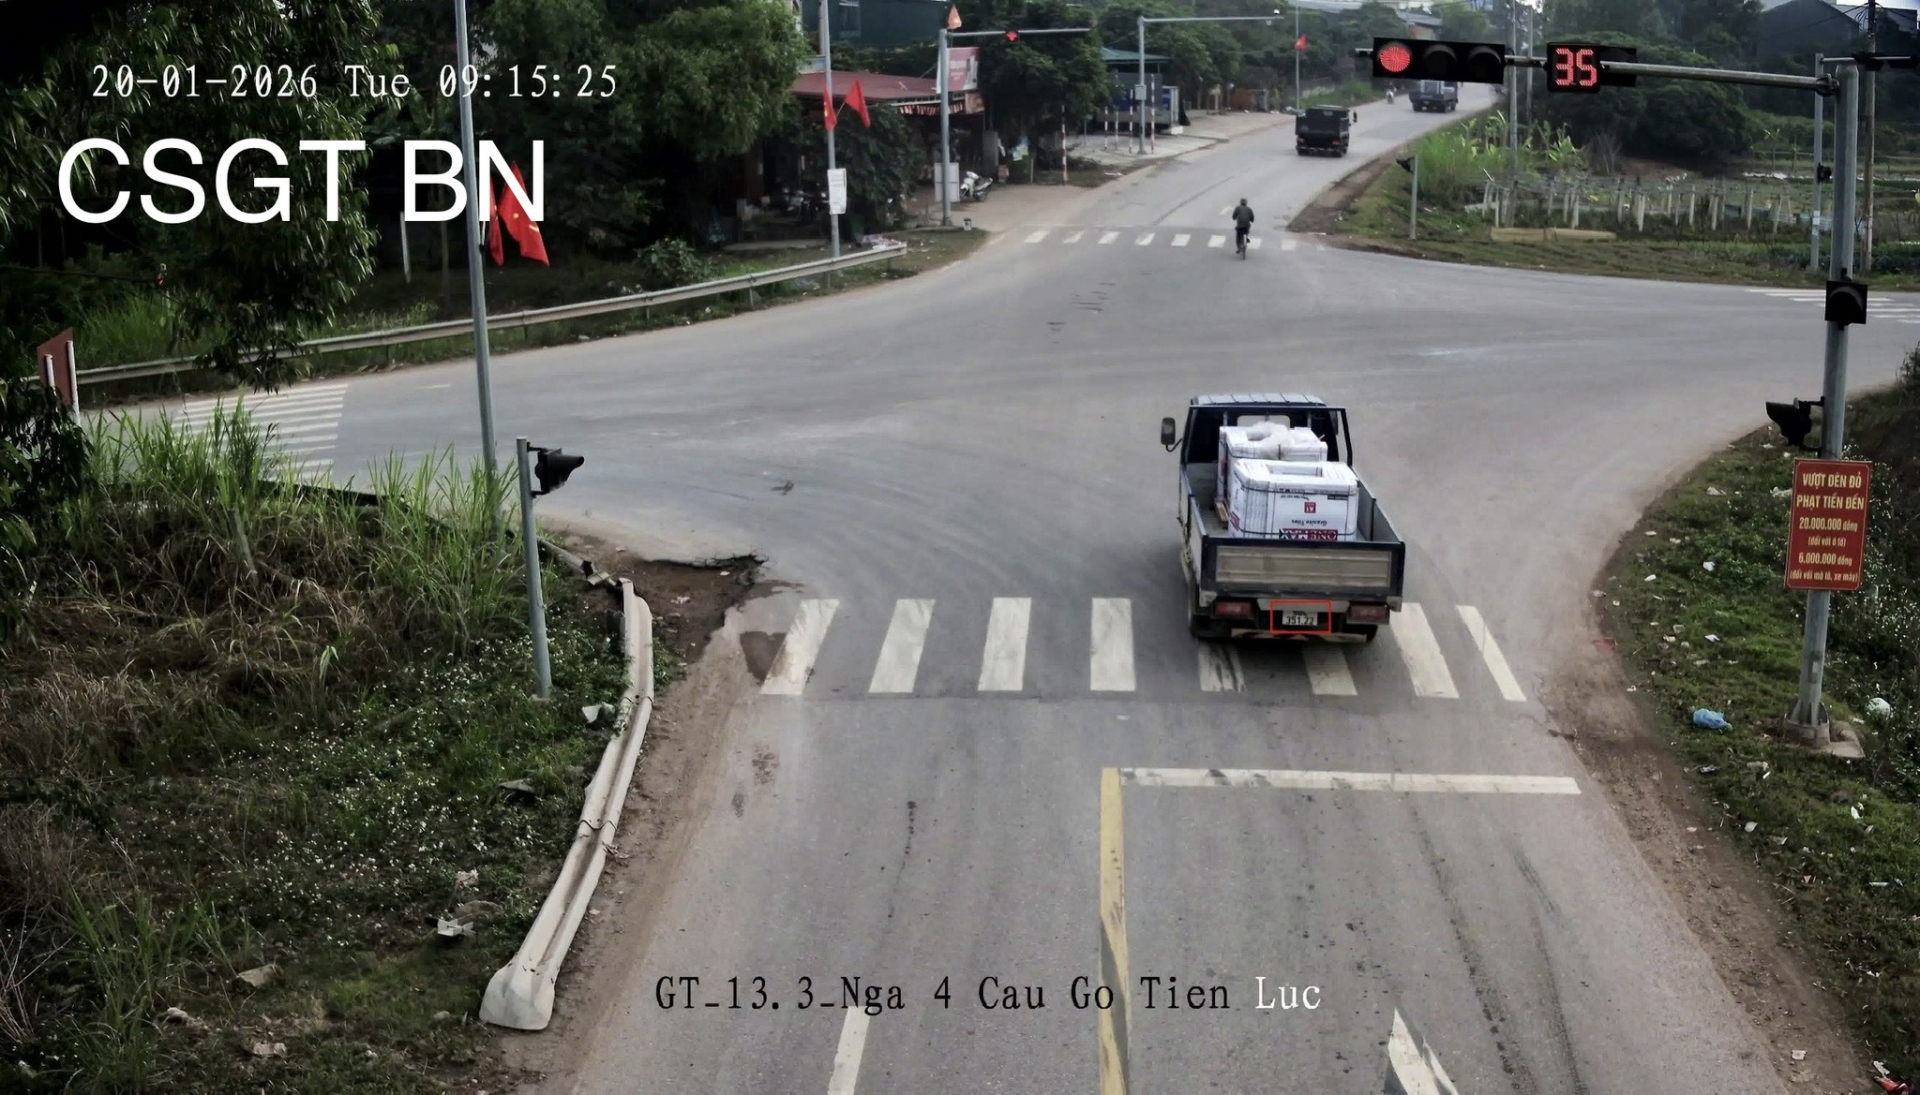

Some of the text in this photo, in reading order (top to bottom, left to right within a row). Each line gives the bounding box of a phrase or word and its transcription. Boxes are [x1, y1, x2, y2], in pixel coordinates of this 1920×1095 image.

[1555, 48, 1597, 86] 35
[1802, 472, 1826, 489] VƯỢT
[1848, 471, 1862, 489] ĐỎ
[1796, 494, 1821, 510] PHẠT
[1845, 493, 1865, 510] ĐẾN
[1799, 517, 1842, 530] 20.000.000
[1798, 552, 1837, 565] 6.000.000
